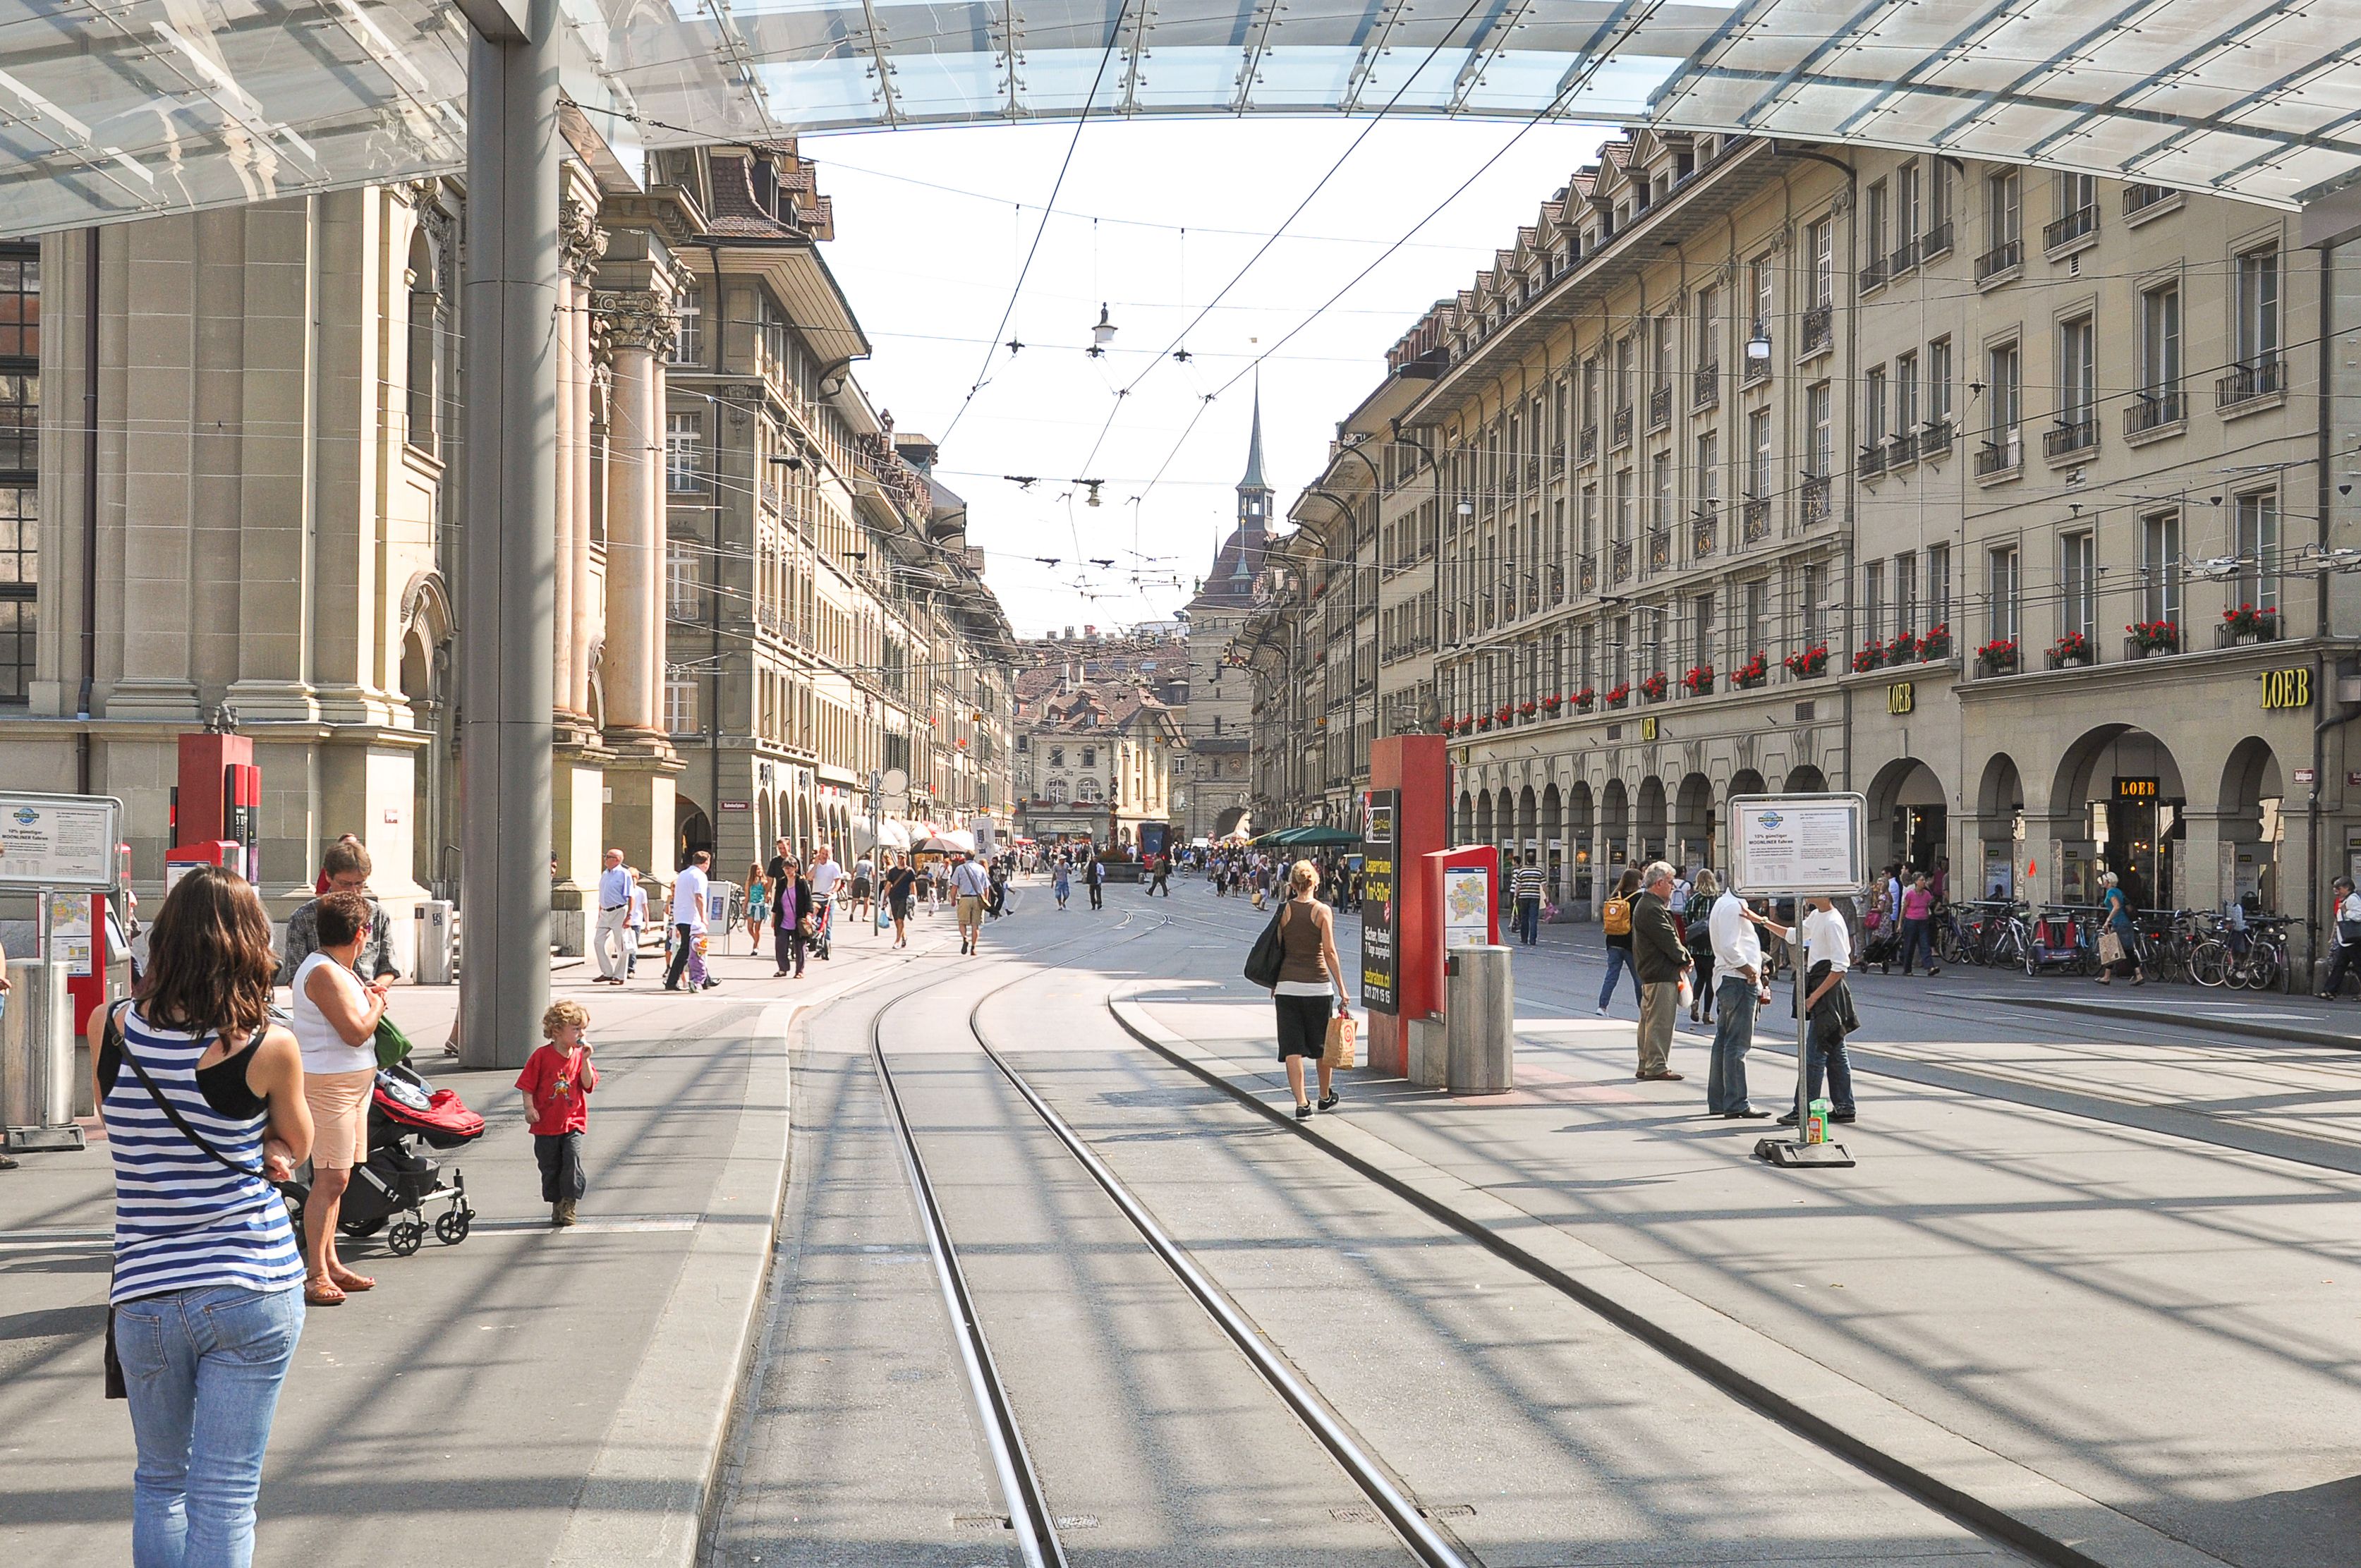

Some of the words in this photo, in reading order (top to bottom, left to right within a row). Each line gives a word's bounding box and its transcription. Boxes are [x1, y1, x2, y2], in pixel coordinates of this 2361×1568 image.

[1887, 683, 1911, 713] LOEB
[2260, 669, 2308, 708] LOEB
[1640, 717, 1656, 740] LOEB
[2120, 781, 2155, 796] LOEB
